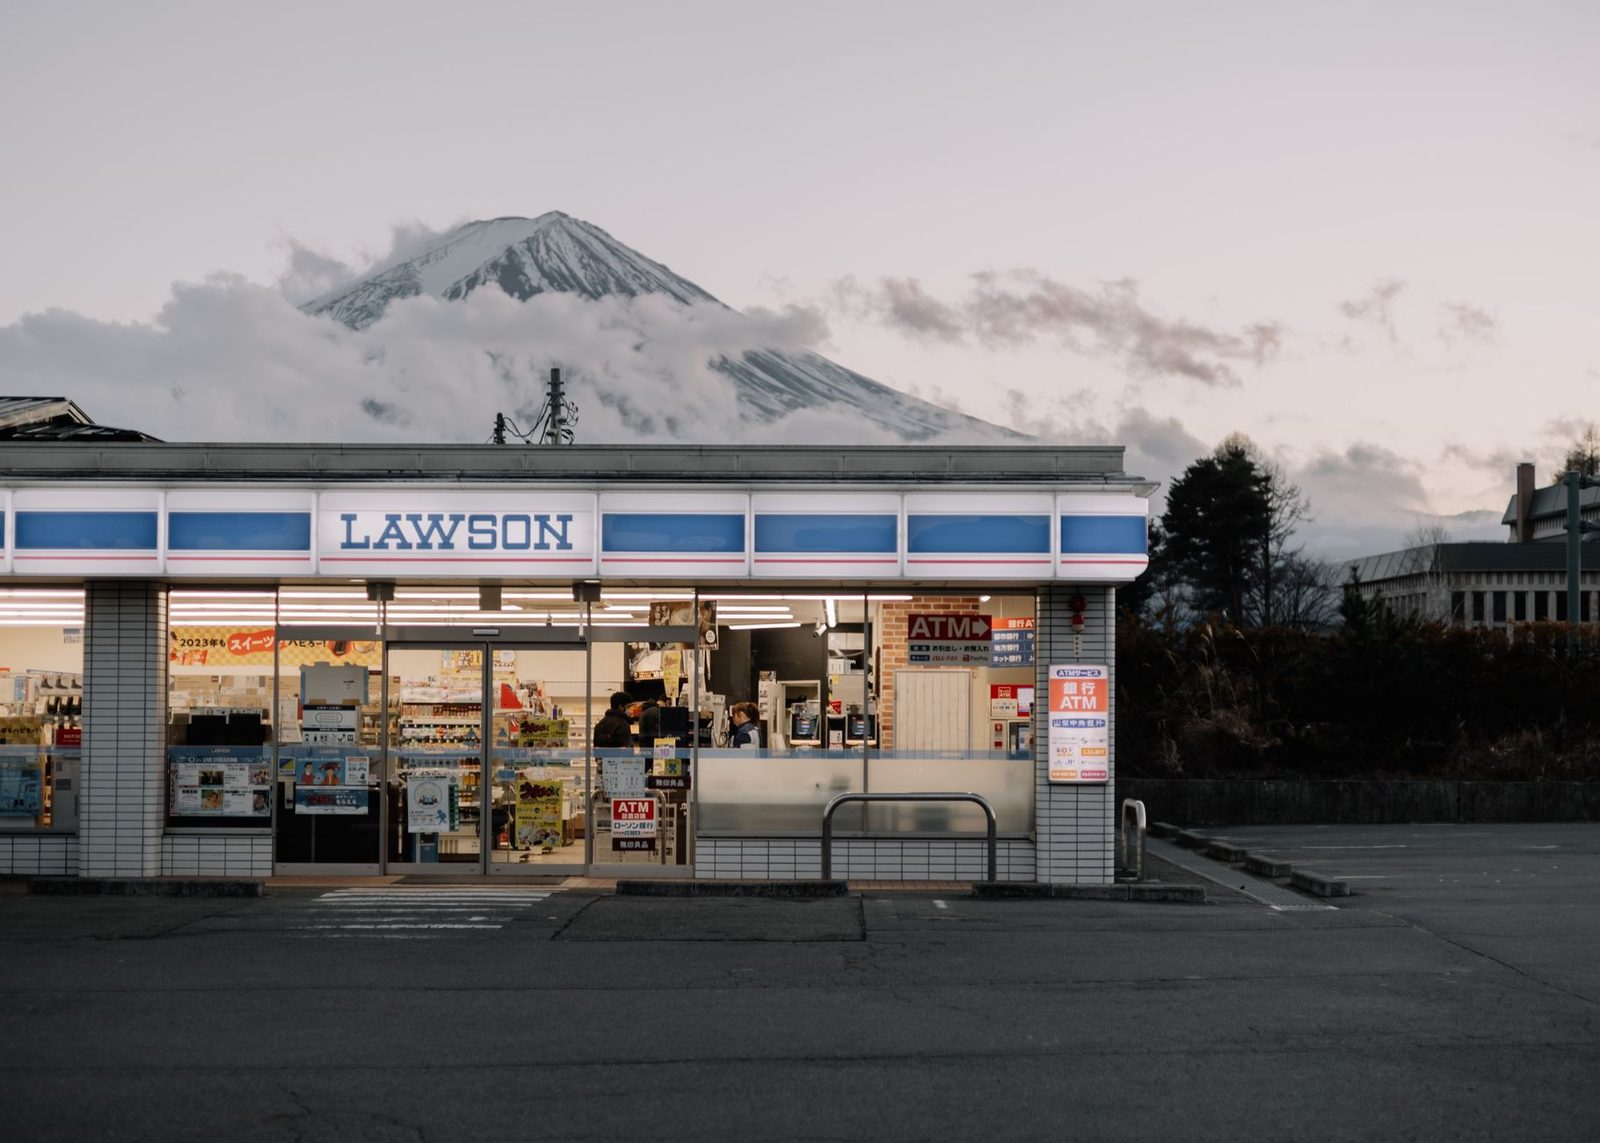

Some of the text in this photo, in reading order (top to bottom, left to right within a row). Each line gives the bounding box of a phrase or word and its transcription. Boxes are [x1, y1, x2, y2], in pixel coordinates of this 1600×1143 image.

[340, 513, 573, 550] LAWSON
[910, 616, 971, 638] ATM
[1008, 619, 1034, 628] 銀行A
[180, 638, 226, 648] 2023年も
[1058, 669, 1100, 677] ATMサービス
[1063, 682, 1096, 695] 銀行
[1060, 696, 1096, 709] ATM
[655, 779, 684, 788] 無印良品
[618, 802, 649, 813] ATM
[620, 841, 648, 849] 無印良品
